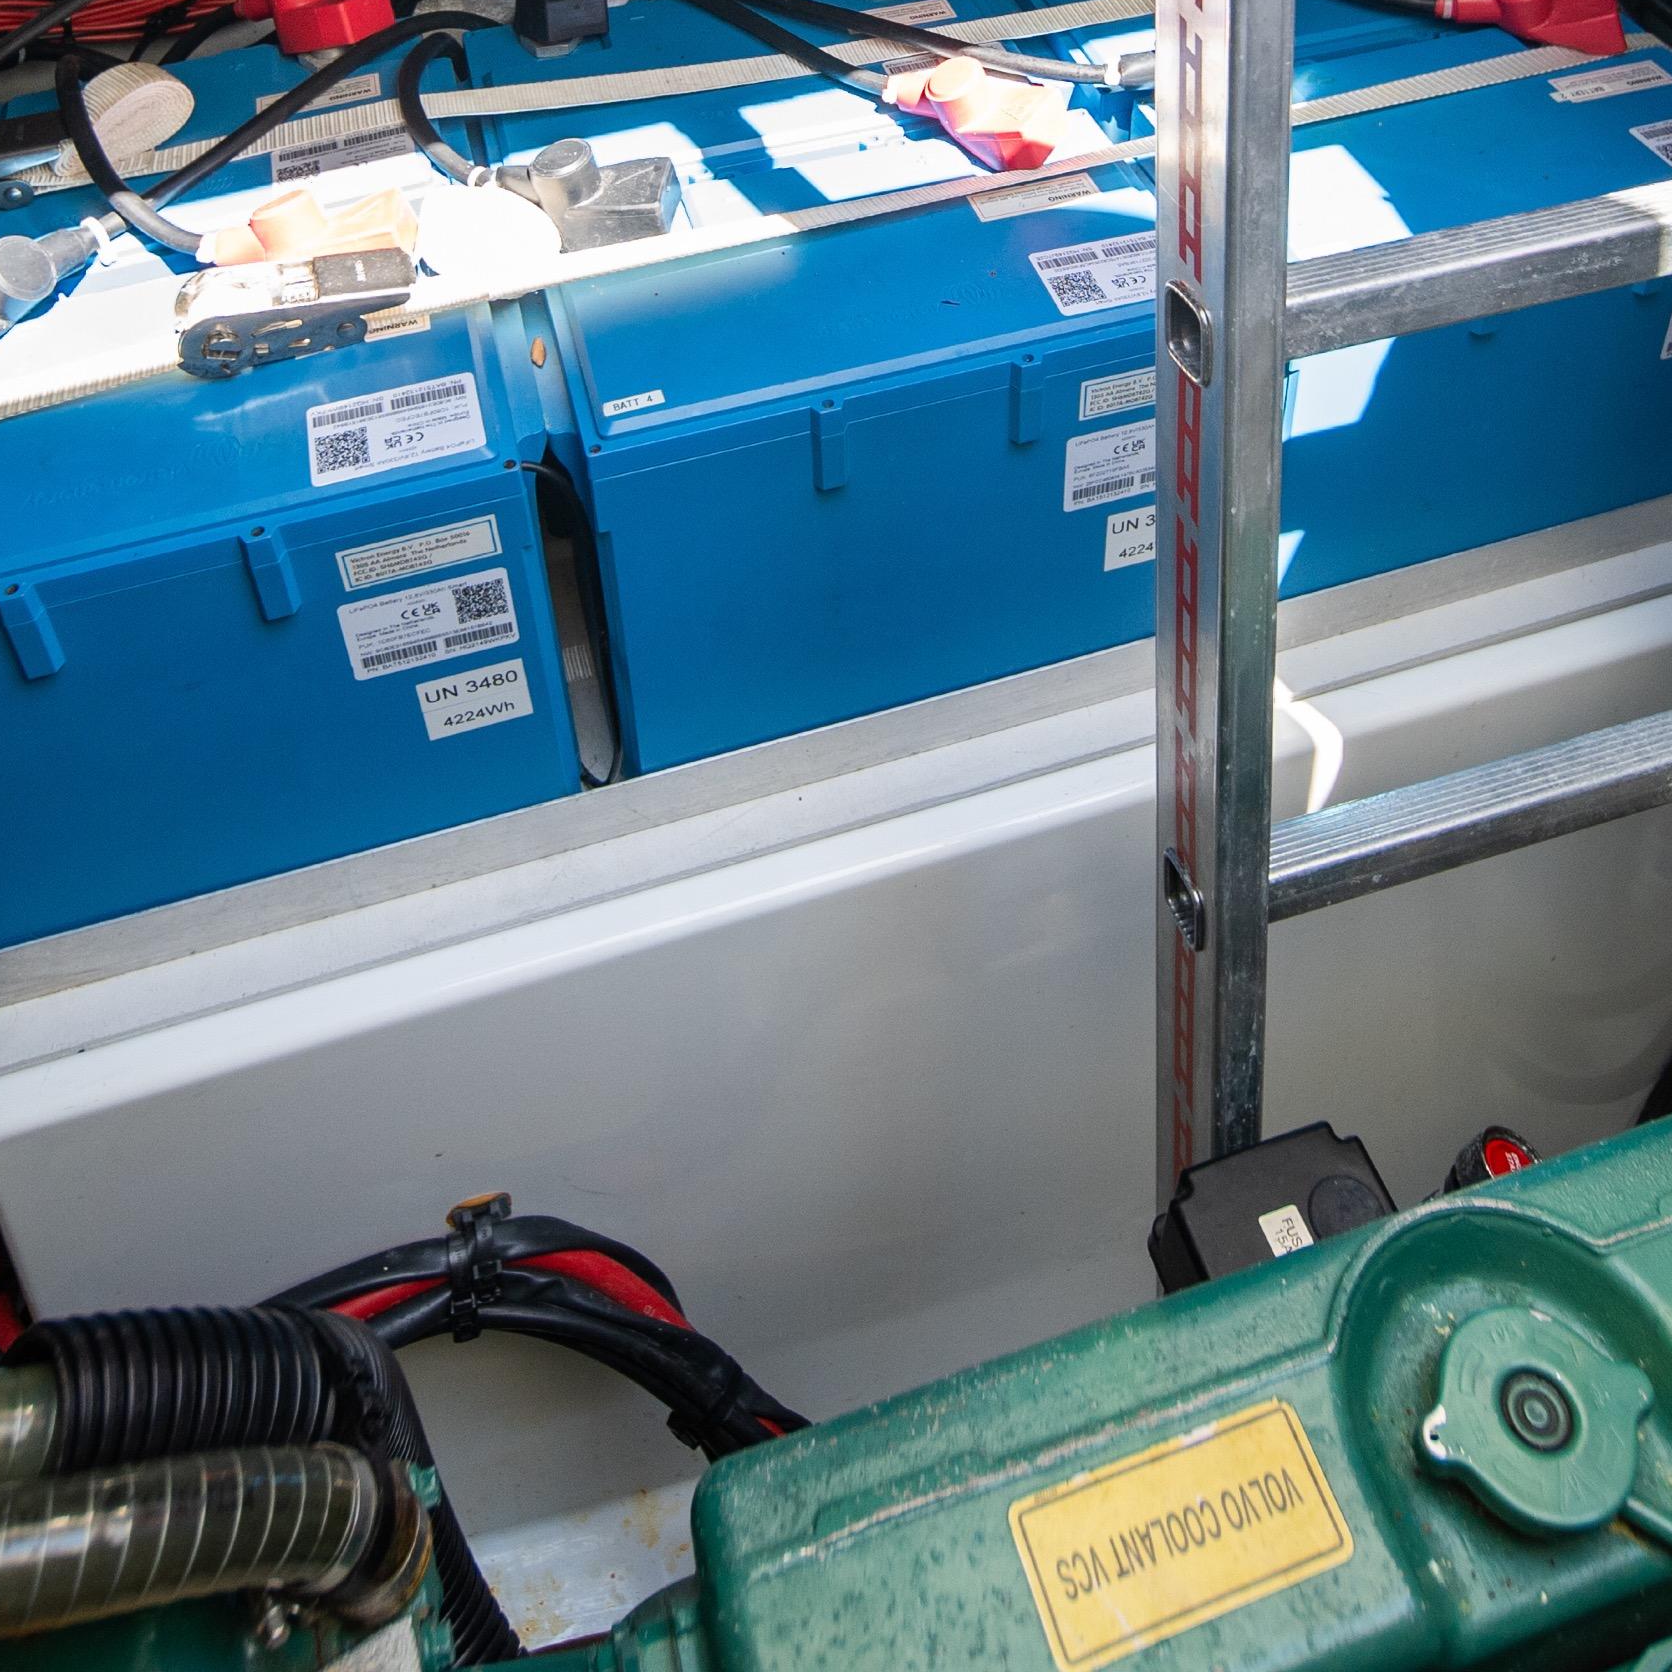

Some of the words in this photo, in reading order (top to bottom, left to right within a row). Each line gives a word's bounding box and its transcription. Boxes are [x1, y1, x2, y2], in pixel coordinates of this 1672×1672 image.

[1048, 190, 1091, 202] WARNING
[612, 397, 637, 413] BATT
[645, 393, 655, 405] 4
[406, 432, 424, 443] CE
[1114, 443, 1129, 455] CE
[1111, 518, 1140, 535] UN
[376, 548, 400, 558] Energy
[435, 536, 448, 544] Box
[1118, 541, 1155, 559] 4224
[380, 597, 403, 607] Battery
[448, 582, 467, 591] Smart
[401, 608, 420, 620] CE
[424, 683, 460, 704] UN
[465, 669, 518, 693] 3480
[443, 699, 516, 728] 4224Wh
[1281, 1215, 1304, 1248] FUS
[1226, 1465, 1306, 1530] VOLVO
[1115, 1499, 1222, 1581] COOLANT
[1055, 1544, 1110, 1602] VCS
